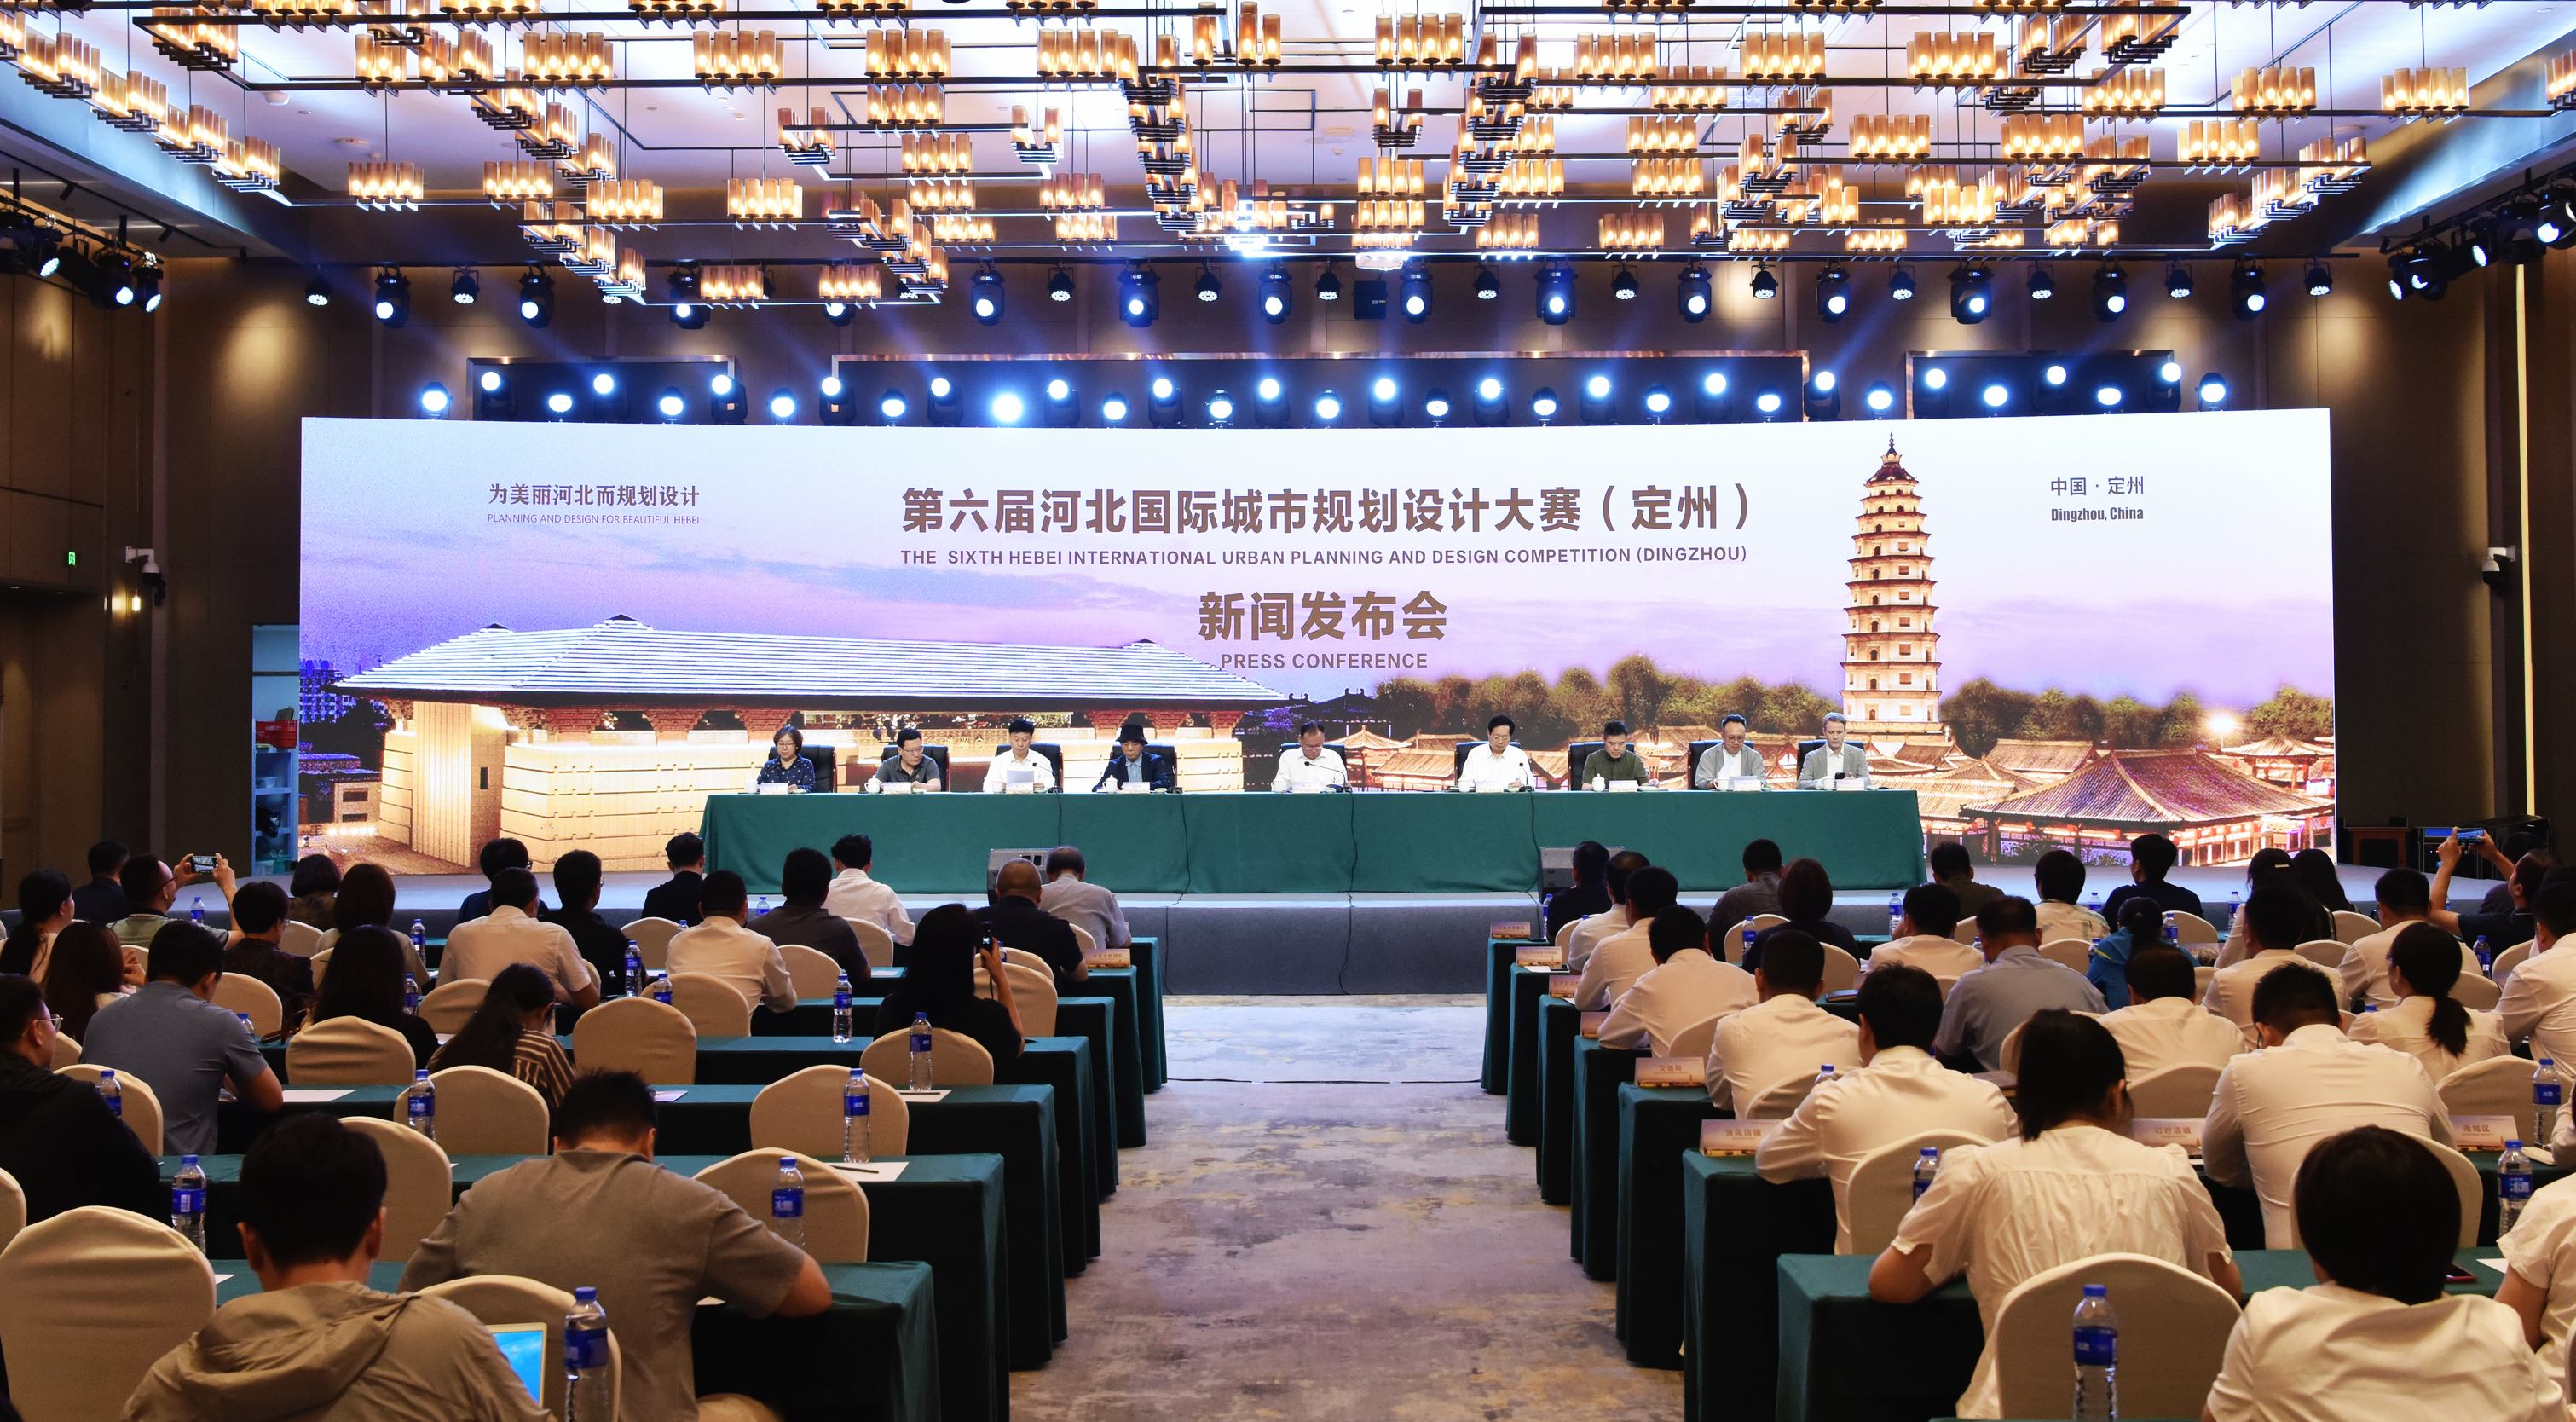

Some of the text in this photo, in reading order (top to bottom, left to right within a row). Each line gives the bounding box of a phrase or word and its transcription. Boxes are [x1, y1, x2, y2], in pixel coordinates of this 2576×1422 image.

[488, 483, 700, 507] 为美丽河北而规划设计
[901, 483, 1748, 534] 第六届河北国际城市规划设计大赛（定州）
[2051, 506, 2144, 523] Dingzhou, China
[488, 513, 699, 525] PLANNING AND DESIGN FOR BEAUTIFUL HEBEI
[901, 546, 1747, 564] THE SIXTH HEBEI INTERNATIONAL URBAN PLANNING AND DESIGN COMPETITION (DINGZHOU)
[1198, 591, 1447, 641] 新闻发布会
[1221, 653, 1428, 669] PRESS CONFERENCE
